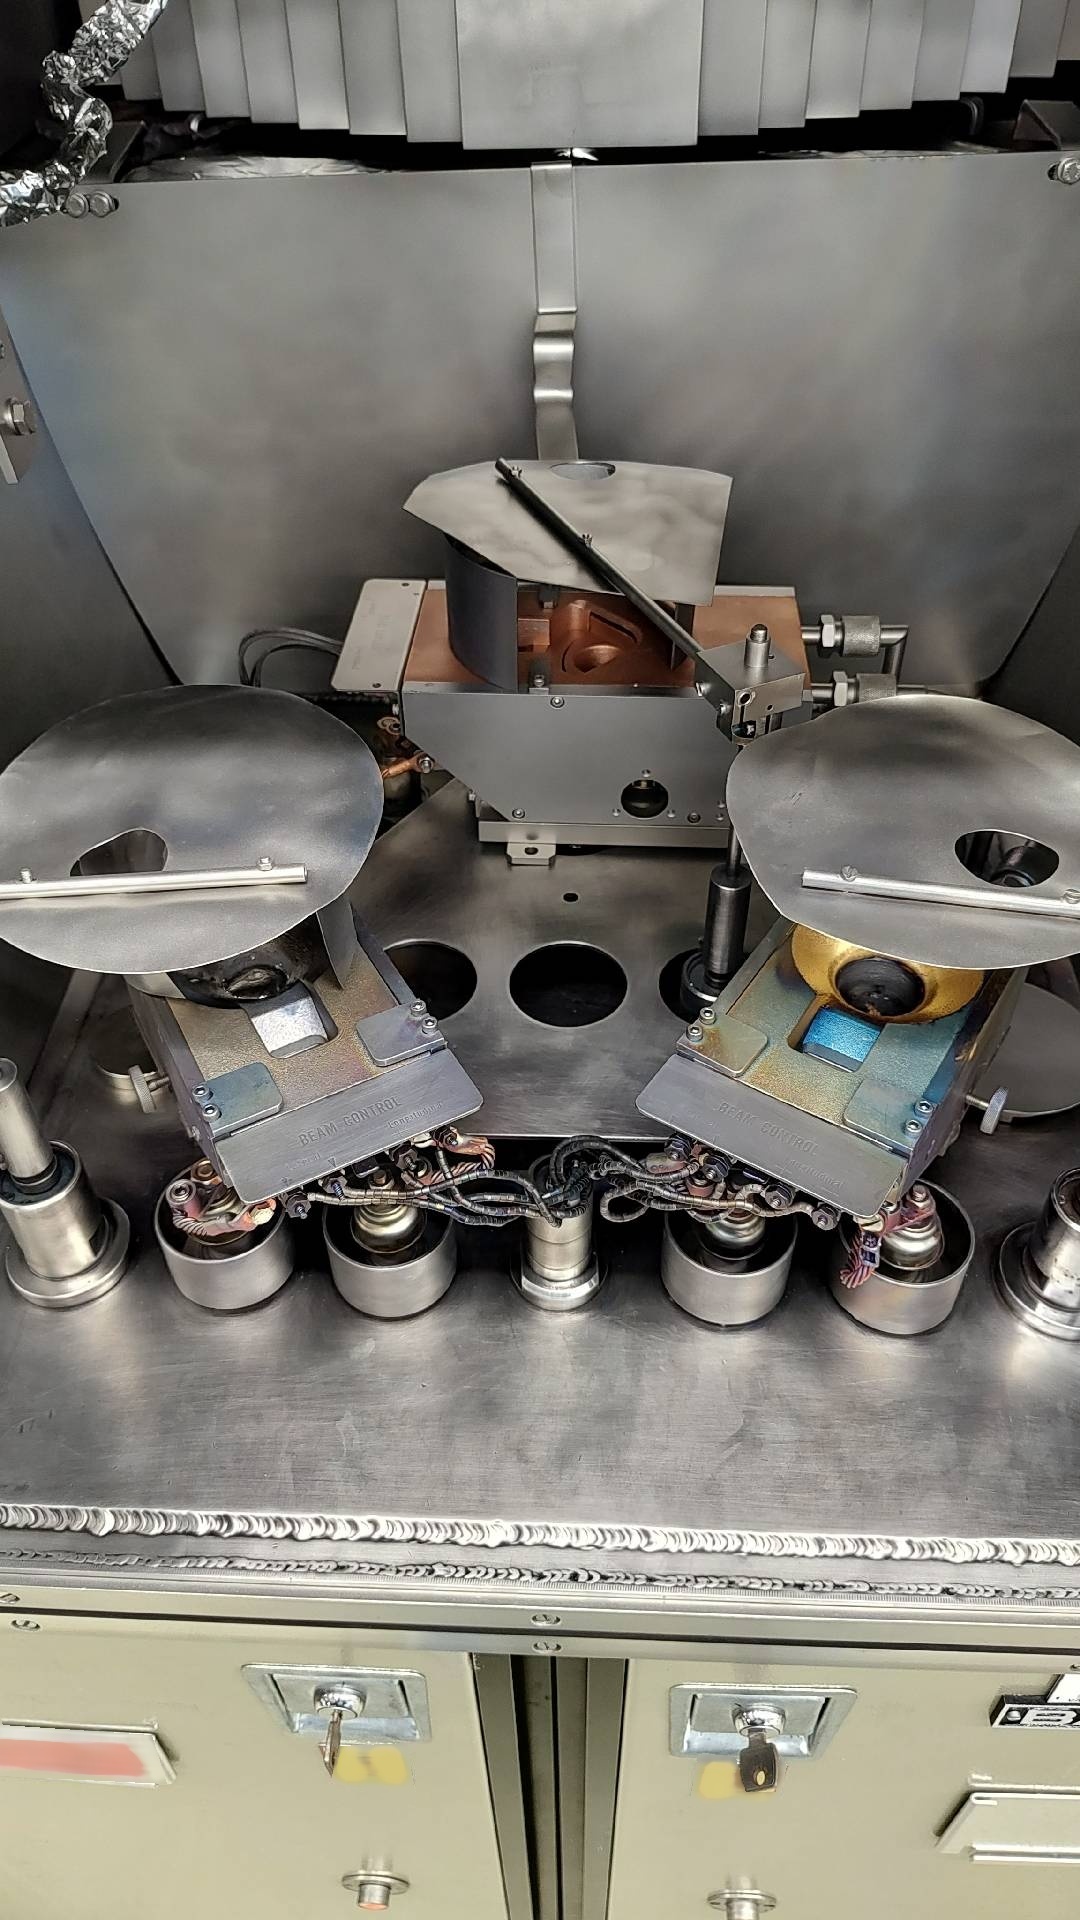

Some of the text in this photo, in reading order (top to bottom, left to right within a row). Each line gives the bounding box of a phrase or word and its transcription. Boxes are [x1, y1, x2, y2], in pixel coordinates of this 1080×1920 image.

[298, 1095, 402, 1146] BEAM CONTROL
[717, 1101, 754, 1127] BEAM
[758, 1121, 819, 1156] CONTROL
[1020, 1708, 1080, 1726] B
